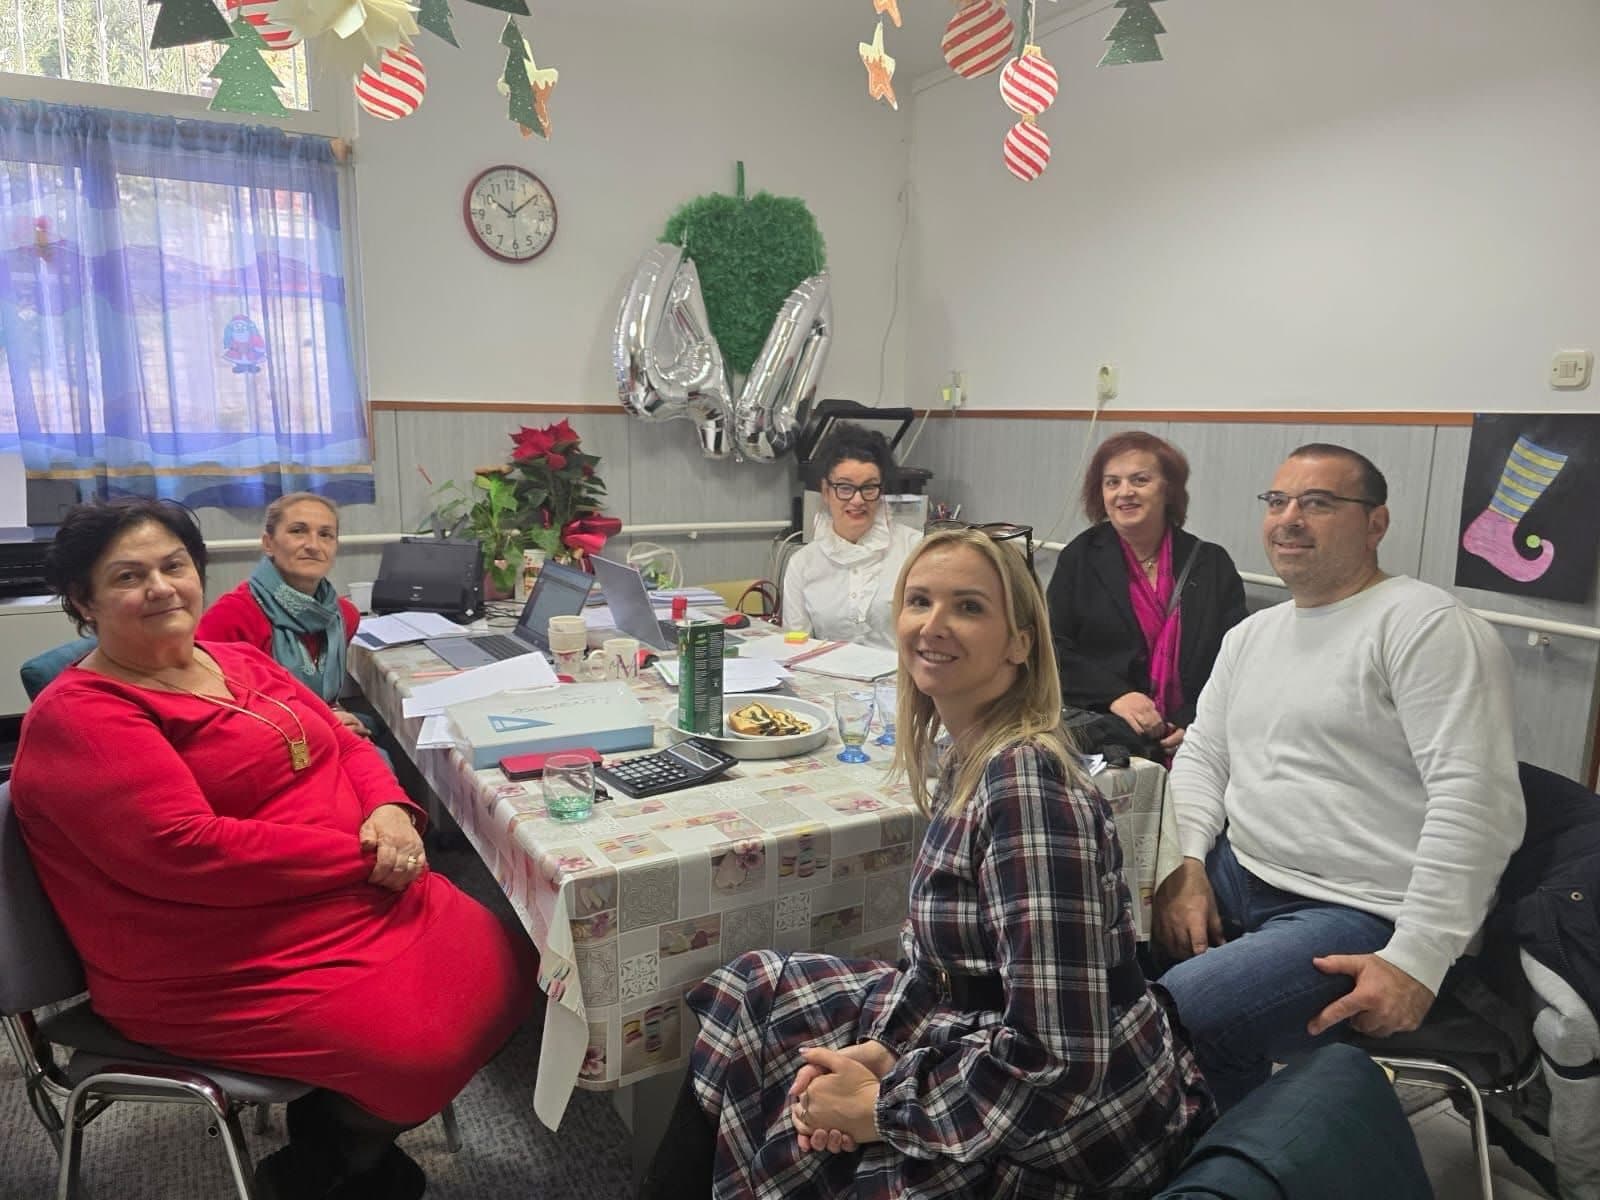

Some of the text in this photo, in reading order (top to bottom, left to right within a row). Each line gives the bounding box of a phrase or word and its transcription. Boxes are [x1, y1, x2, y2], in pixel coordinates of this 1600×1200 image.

[490, 183, 501, 195] 11
[504, 179, 515, 191] 12
[521, 183, 527, 196] 1
[480, 193, 493, 205] 10
[478, 208, 485, 220] 9
[538, 210, 545, 222] 3
[485, 223, 492, 235] 8
[497, 234, 504, 246] 7
[512, 239, 519, 250] 6
[526, 235, 533, 246] 5
[615, 654, 638, 679] M
